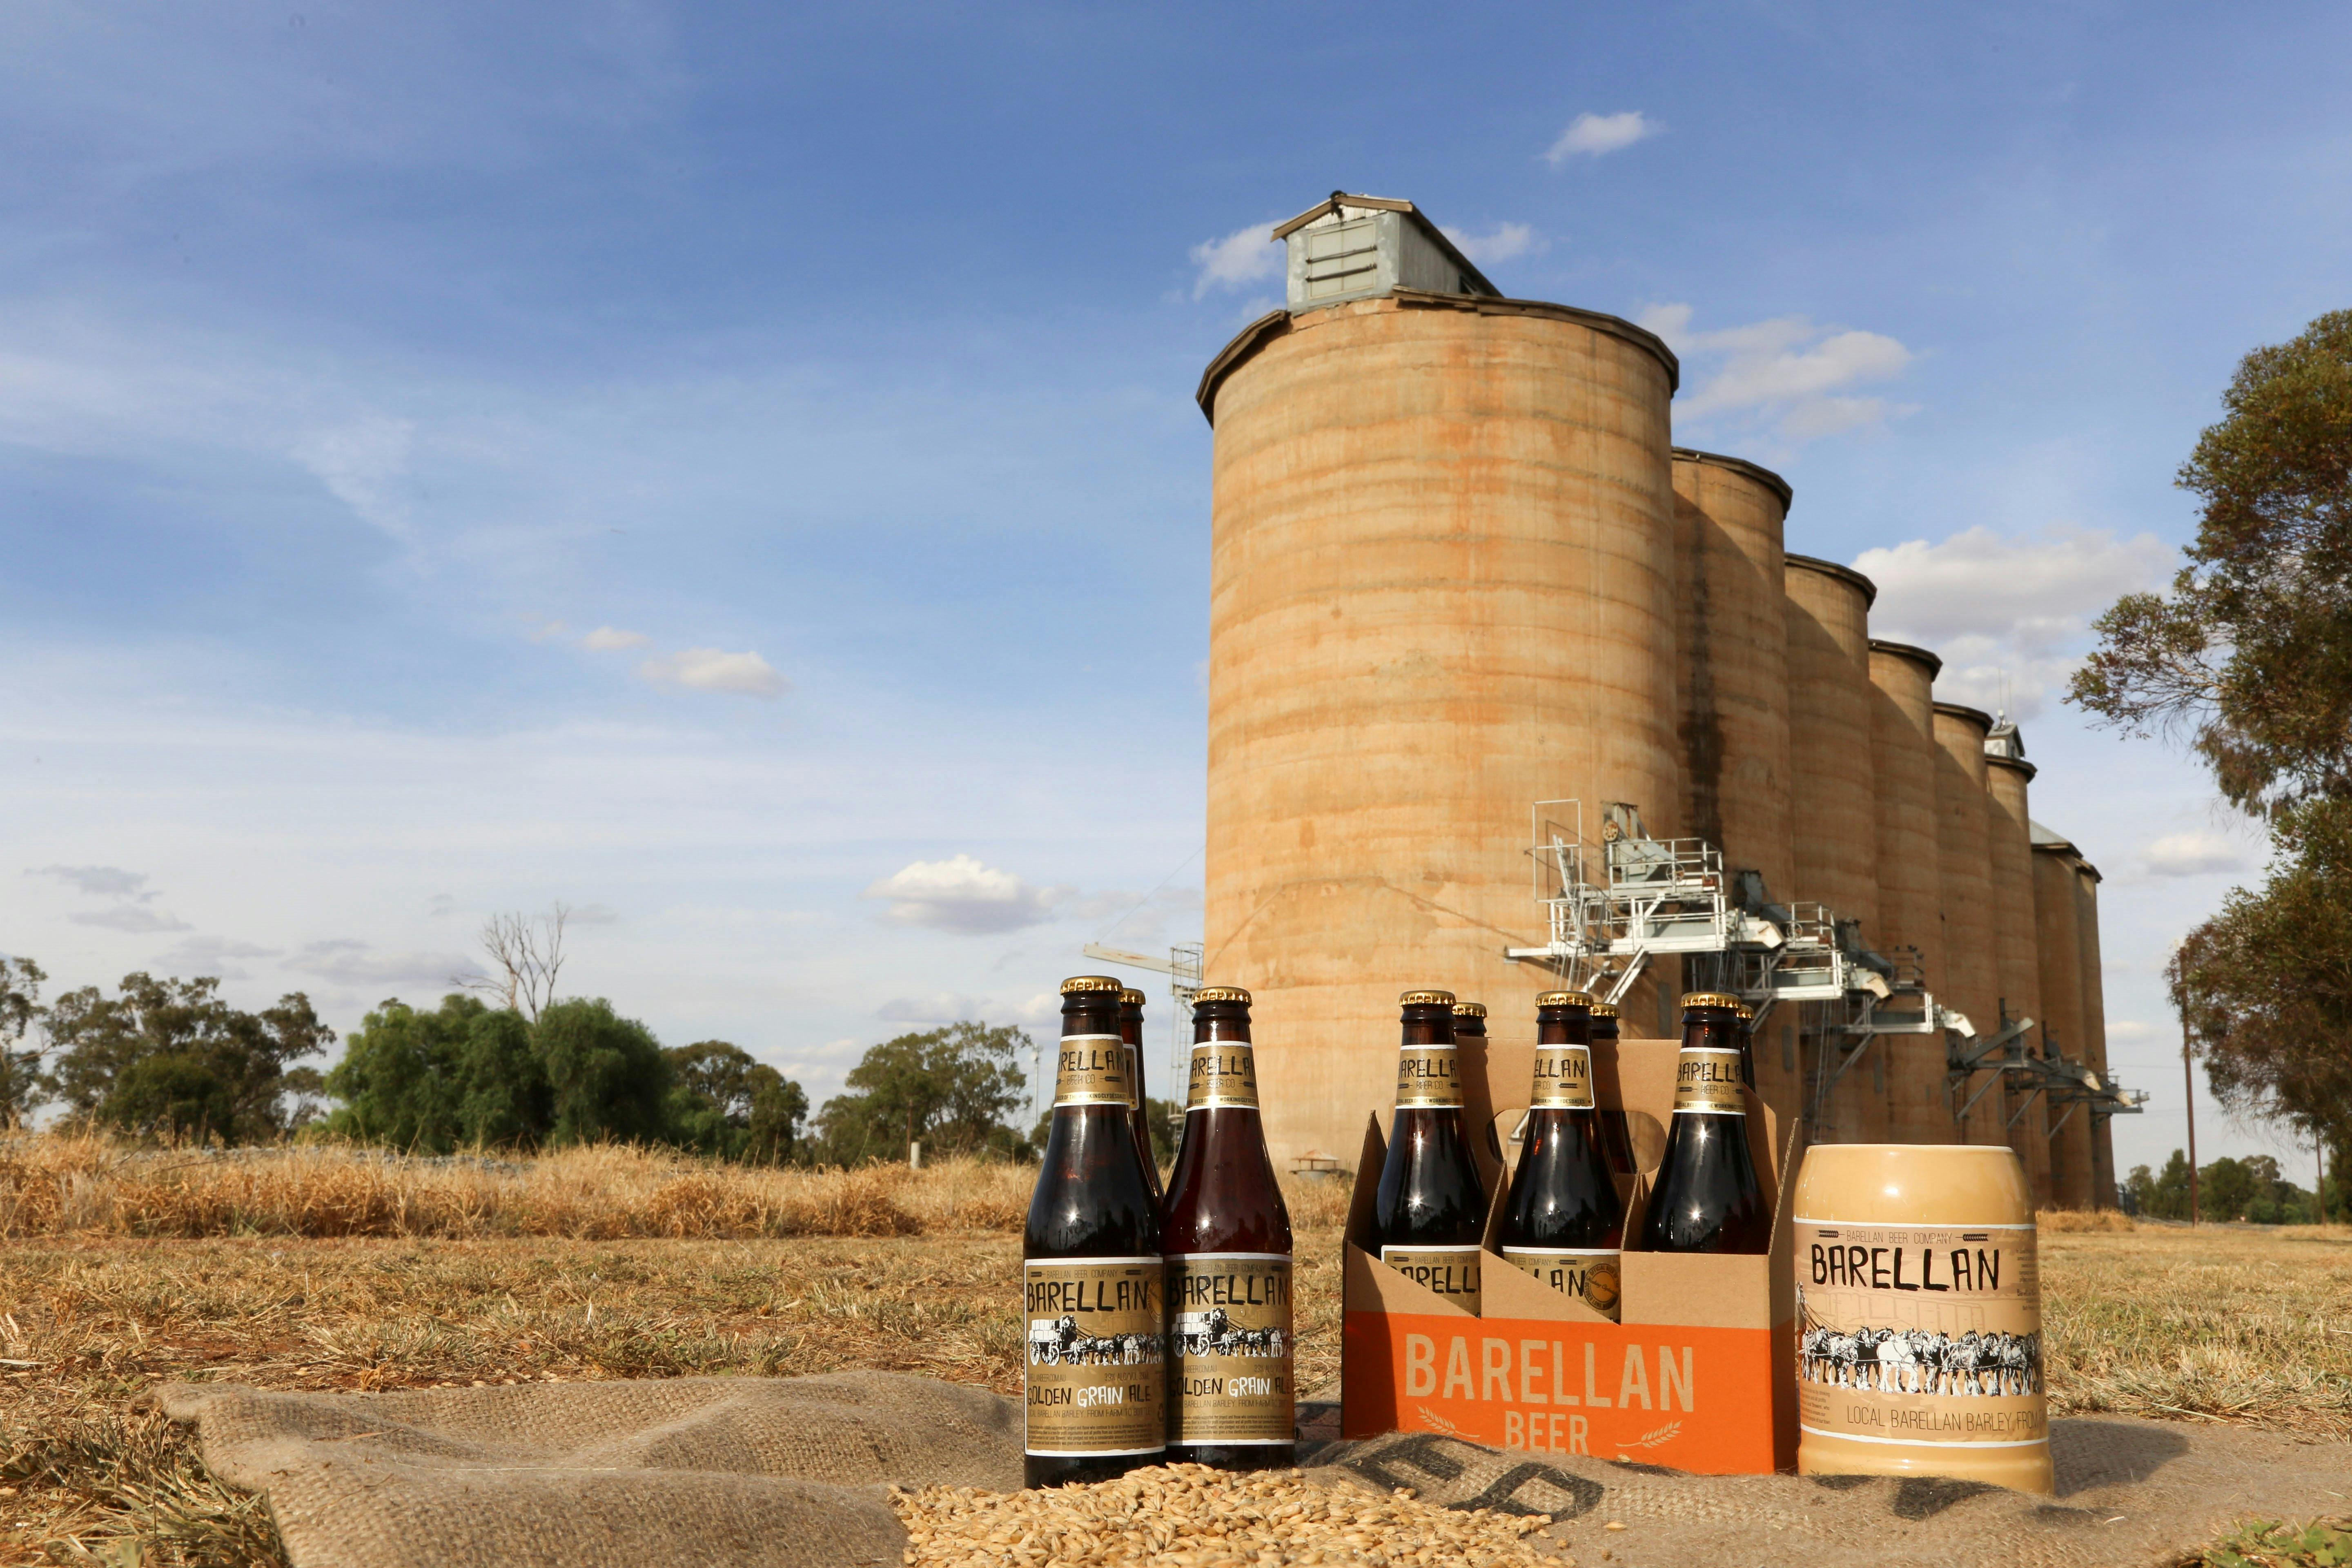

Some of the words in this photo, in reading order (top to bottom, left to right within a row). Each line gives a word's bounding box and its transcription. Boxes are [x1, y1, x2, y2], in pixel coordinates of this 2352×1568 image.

[1067, 1075, 1082, 1085] BEER
[1085, 1074, 1095, 1084] CO
[1226, 1078, 1235, 1088] CO
[1417, 1080, 1432, 1089] BEER
[1434, 1080, 1443, 1089] CO
[1543, 1081, 1550, 1089] CO
[1701, 1085, 1718, 1094] BEER
[1721, 1085, 1729, 1095] CO
[1847, 1230, 1883, 1243] BARELLAN
[1889, 1232, 1908, 1244] BEER
[1914, 1232, 1952, 1244] COMPANY
[1415, 1256, 1439, 1264] BARELLAN
[1225, 1264, 1238, 1272] BEER
[1242, 1264, 1265, 1272] COMPANY
[1812, 1244, 1999, 1291] BARELLAN
[1047, 1270, 1071, 1278] BARELLAN
[1074, 1270, 1087, 1278] BEER
[1091, 1269, 1118, 1278] COMPANY
[1169, 1274, 1287, 1306] BARELLAN
[1027, 1280, 1148, 1312] BARELLAN
[1117, 1372, 1138, 1381] ALC/VOL
[1405, 1333, 1694, 1412] BARELLAN
[1169, 1376, 1223, 1396] GOLDEN
[1228, 1376, 1270, 1398] GRAIN
[1275, 1376, 1290, 1395] ALE
[1028, 1385, 1071, 1406] GOLDEN
[1077, 1385, 1123, 1408] GRAIN
[1129, 1384, 1151, 1403] ALE
[1184, 1399, 1211, 1408] BARELLAN
[1238, 1399, 1254, 1408] FROM
[1256, 1399, 1270, 1407] FARM
[1038, 1410, 1060, 1418] BARELLAN
[1087, 1408, 1104, 1418] FROM
[1106, 1408, 1123, 1417] FARM
[1125, 1408, 1132, 1416] TO
[1134, 1407, 1151, 1416] BOTTLE
[1847, 1405, 1885, 1427] LOCAL
[1891, 1409, 1961, 1431] BARELLAN
[2017, 1411, 2038, 1430] FROM
[1505, 1411, 1589, 1454] BEER
